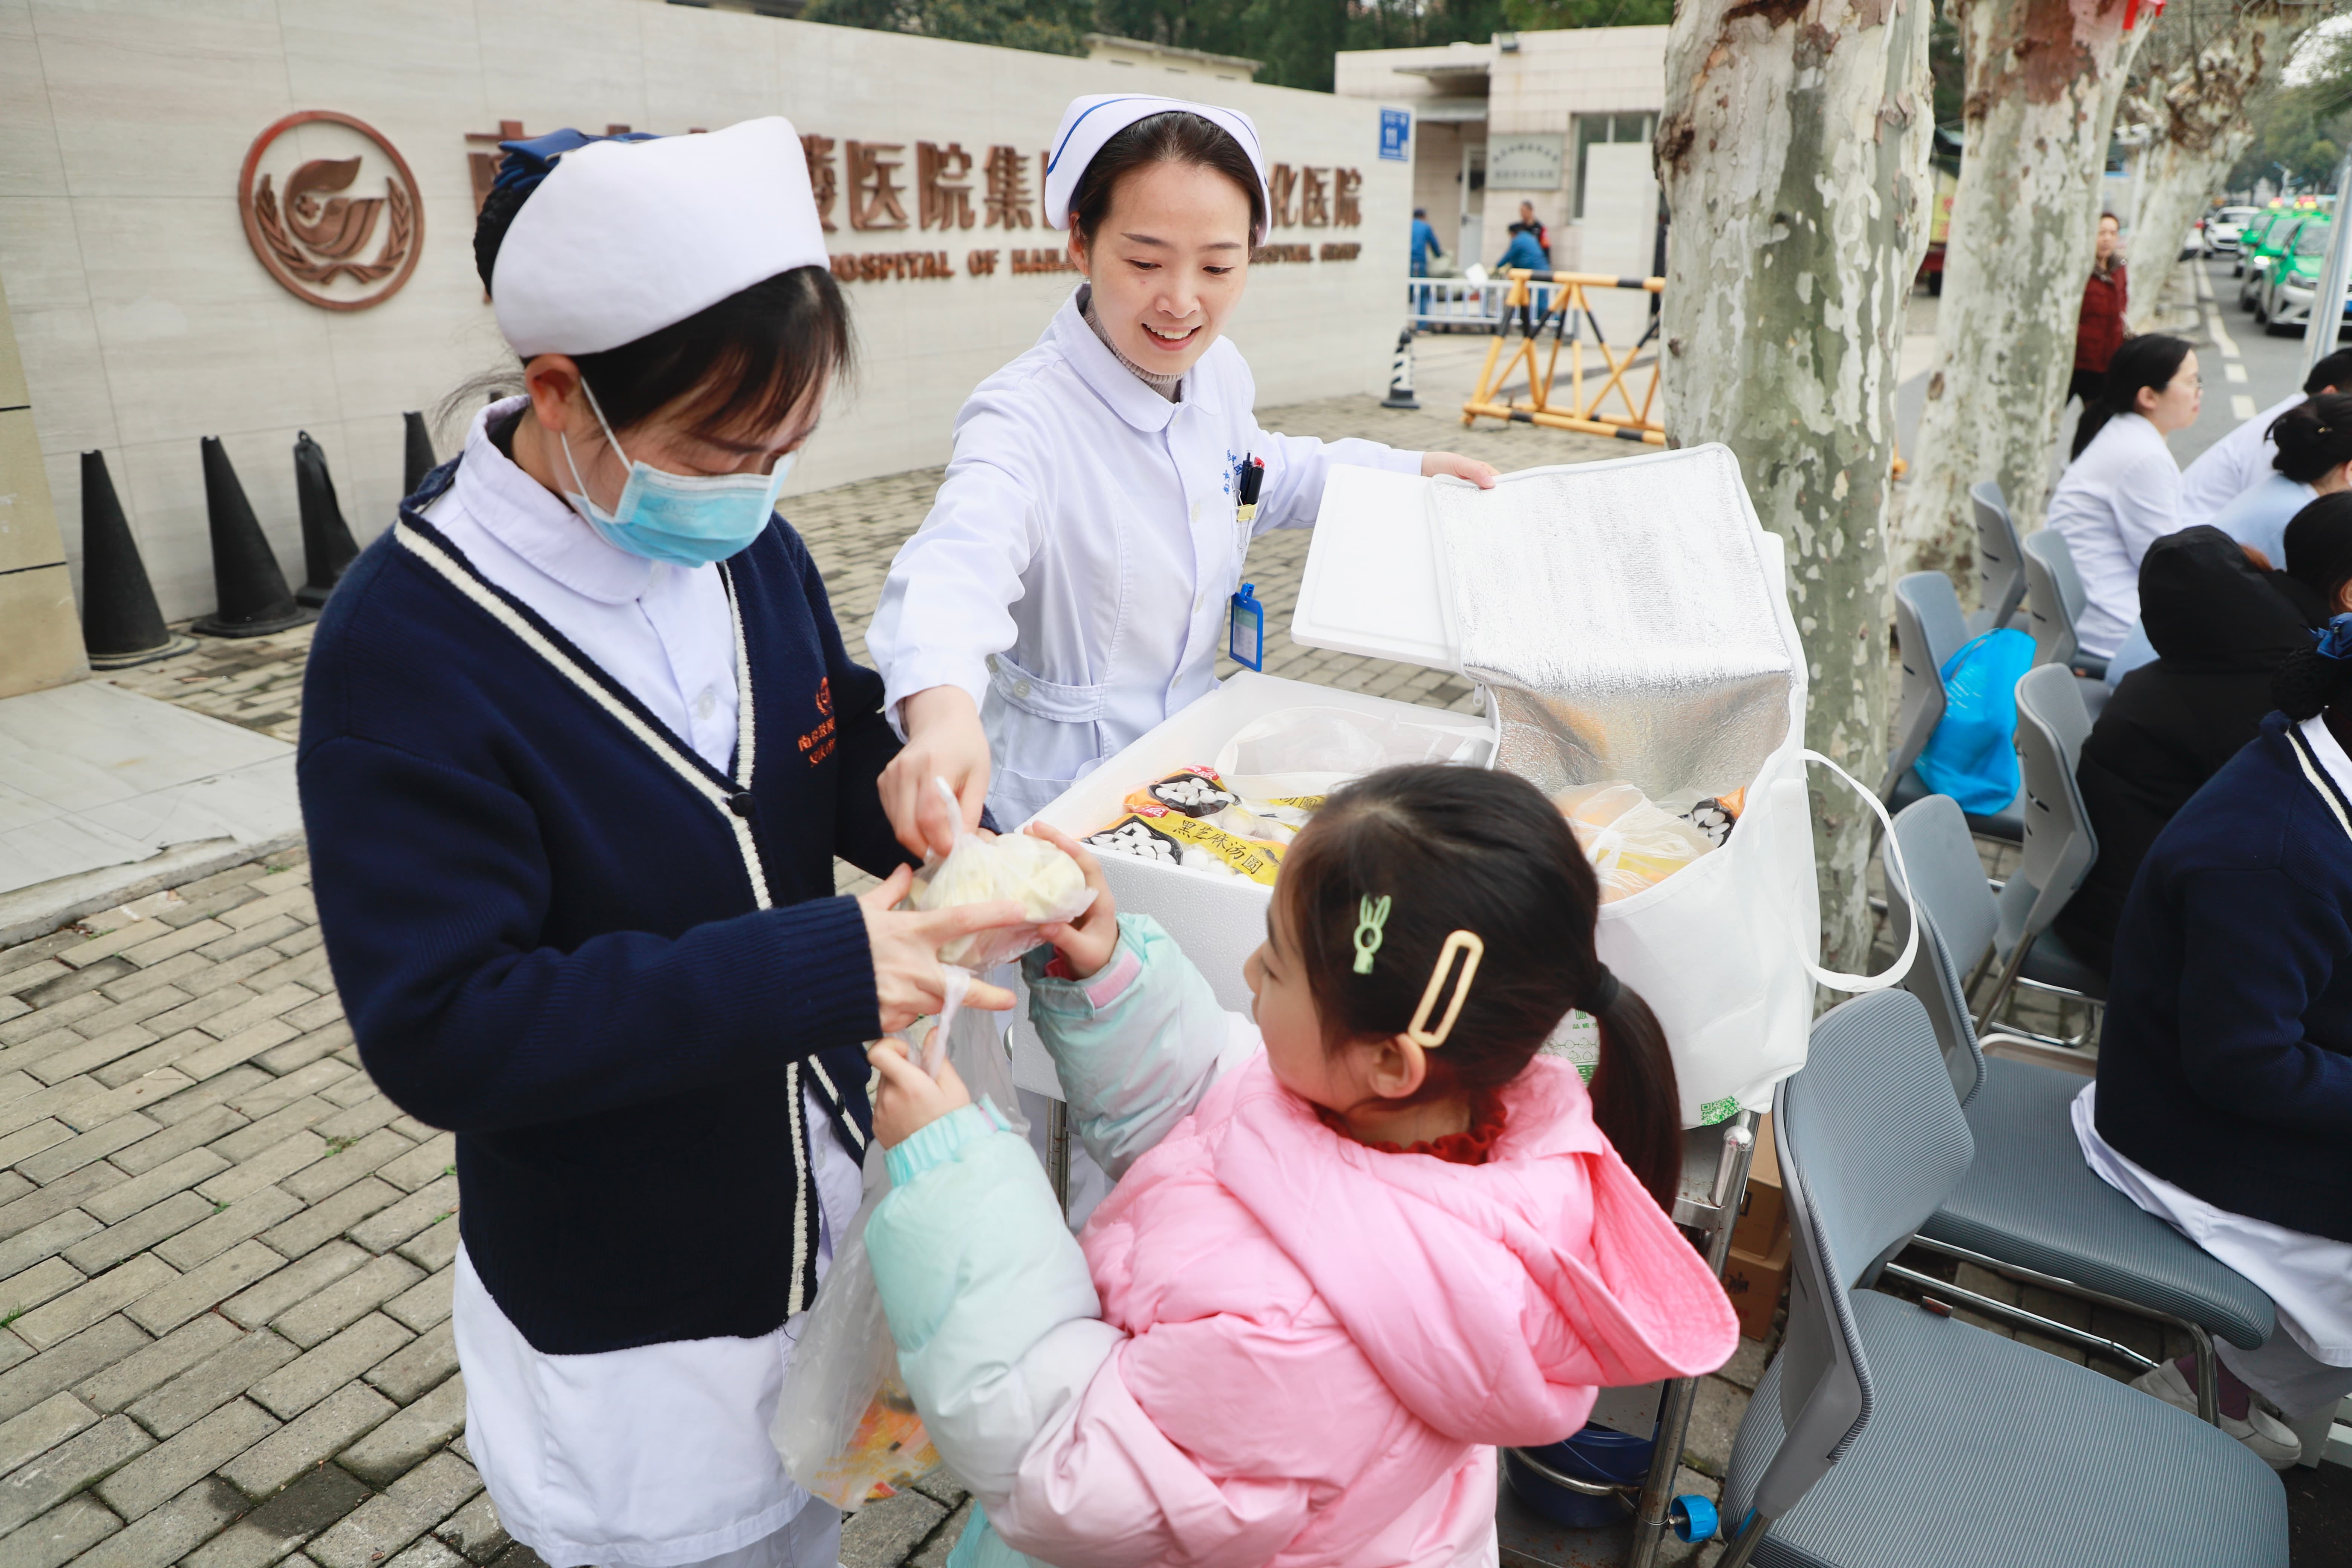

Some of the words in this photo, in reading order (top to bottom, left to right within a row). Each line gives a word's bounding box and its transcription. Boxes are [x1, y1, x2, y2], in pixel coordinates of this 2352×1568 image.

[968, 249, 999, 276] OF
[1173, 820, 1263, 874] 黑芝麻汤圆
